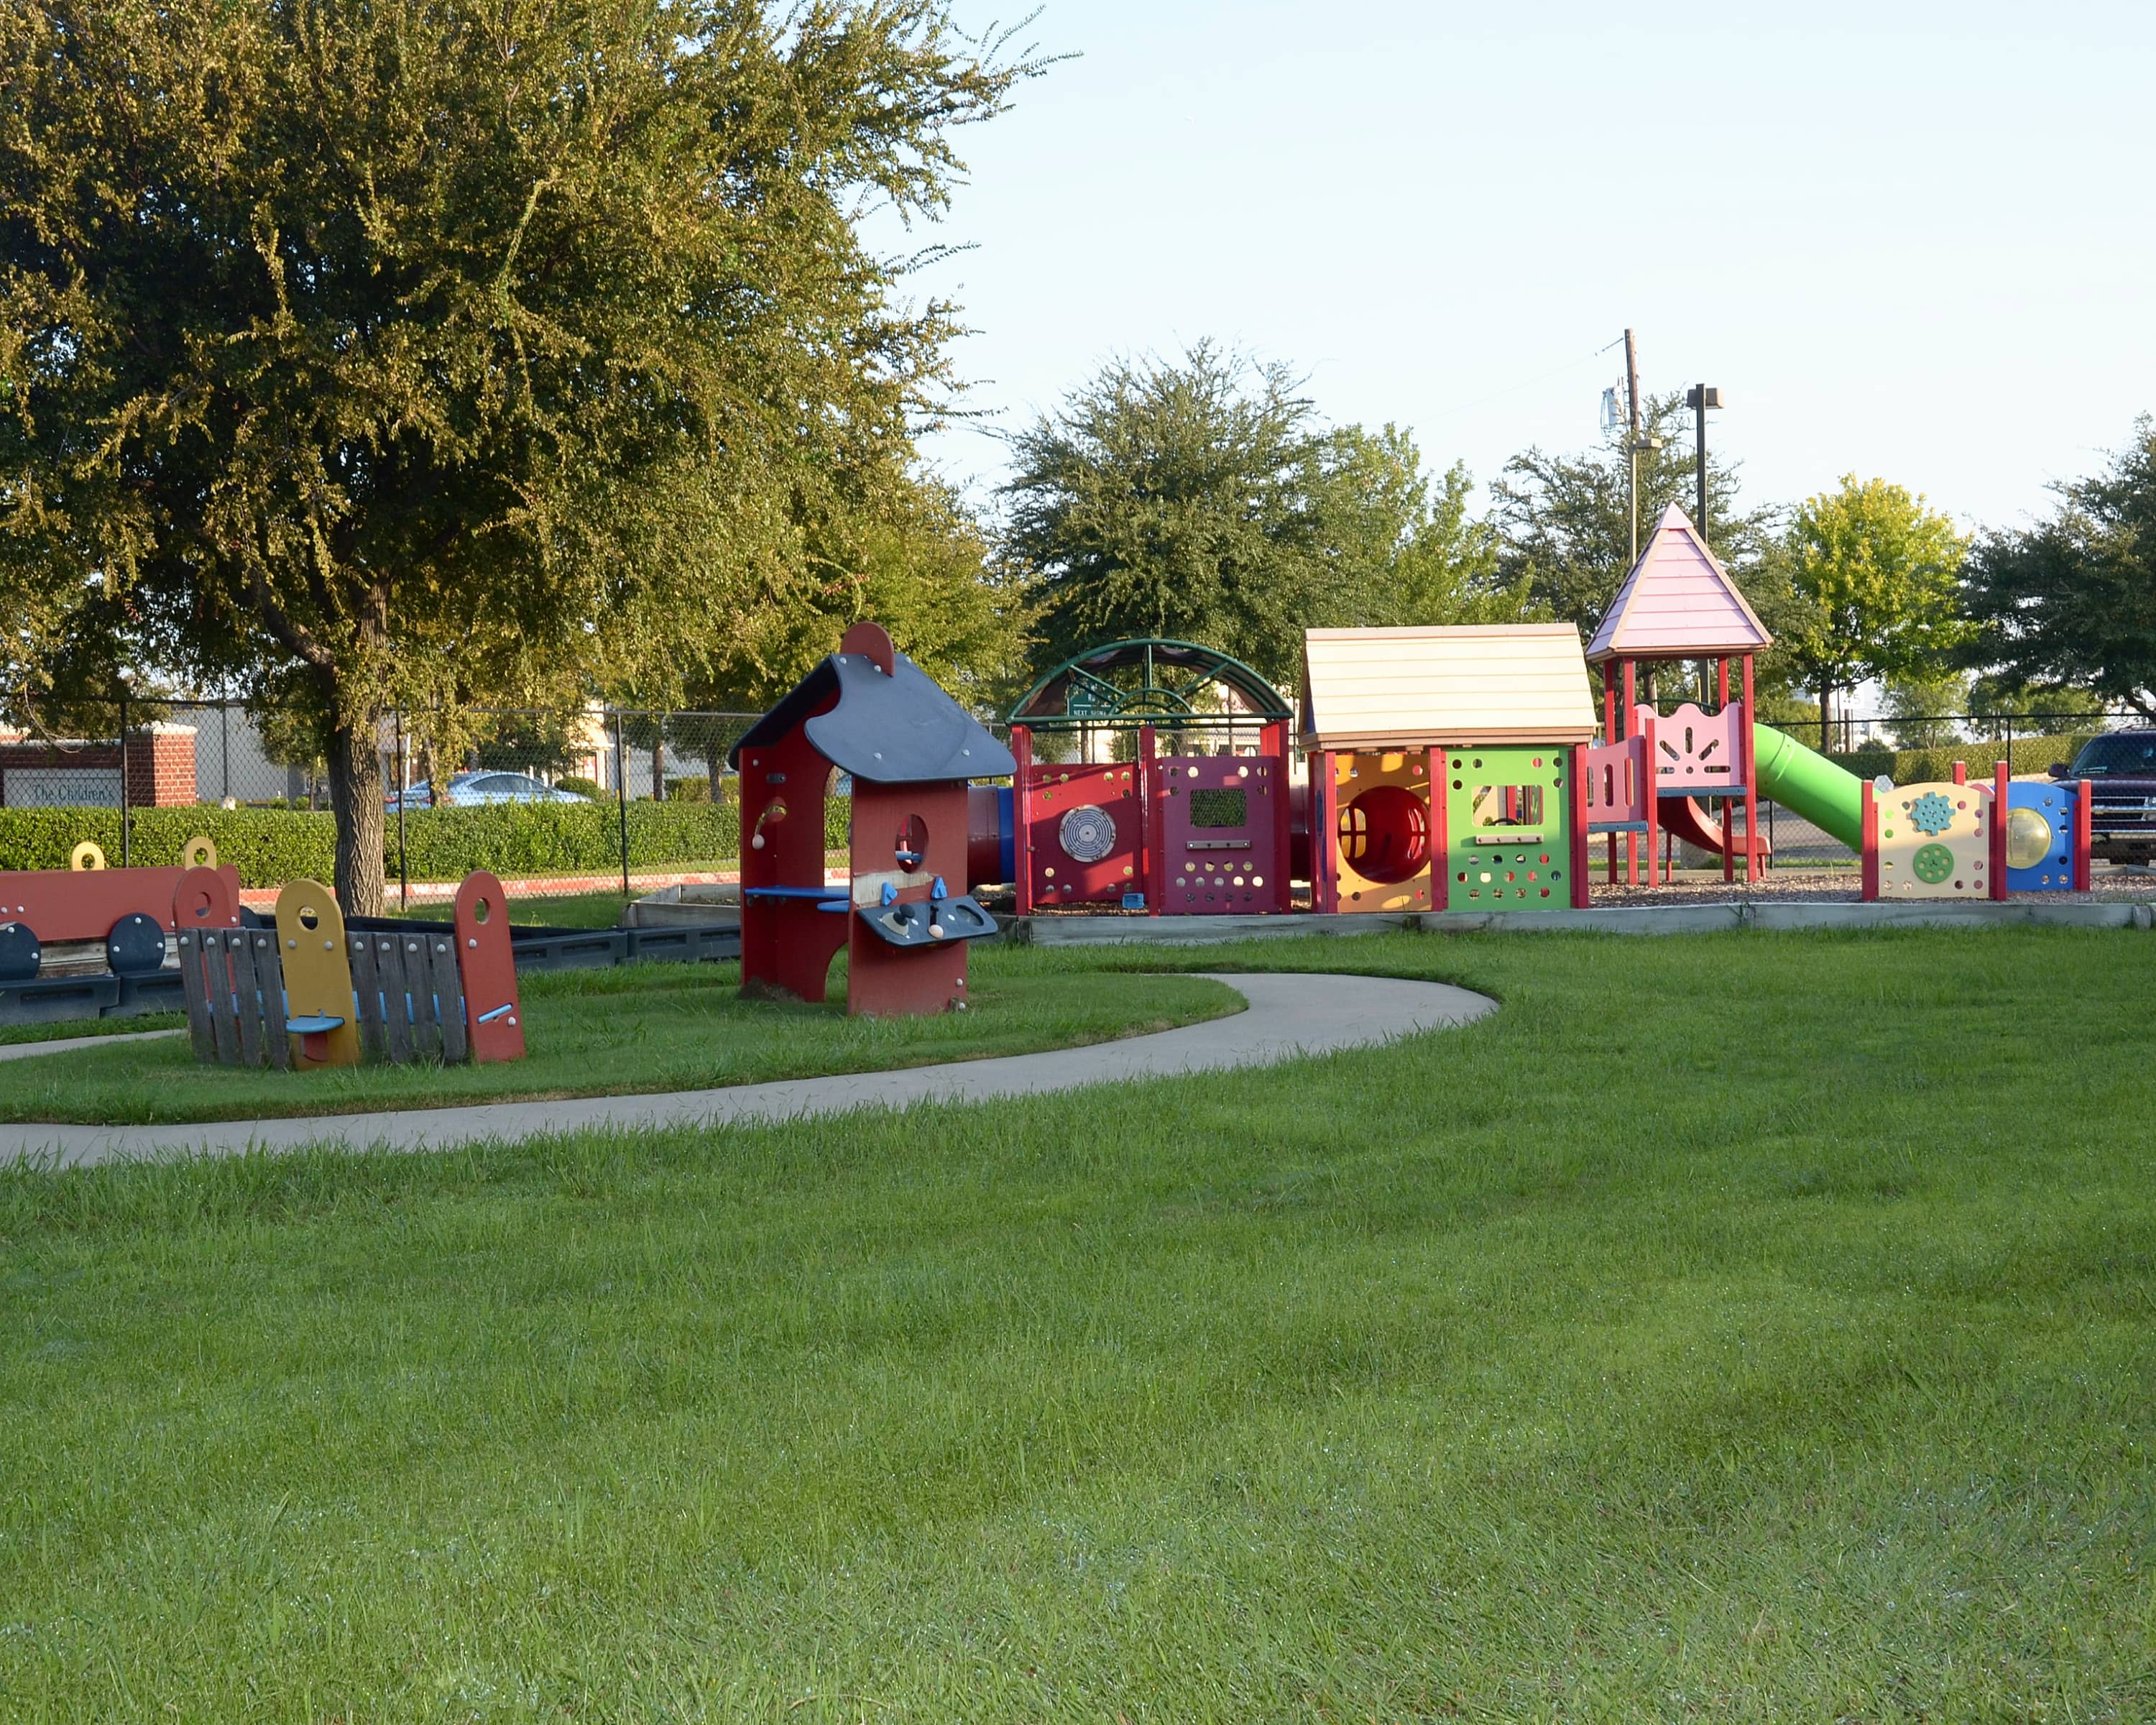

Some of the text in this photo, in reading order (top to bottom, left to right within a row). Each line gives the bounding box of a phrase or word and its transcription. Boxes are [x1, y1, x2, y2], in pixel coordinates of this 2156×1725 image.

[1843, 694, 1861, 704] 45
[34, 784, 116, 801] The Children's
